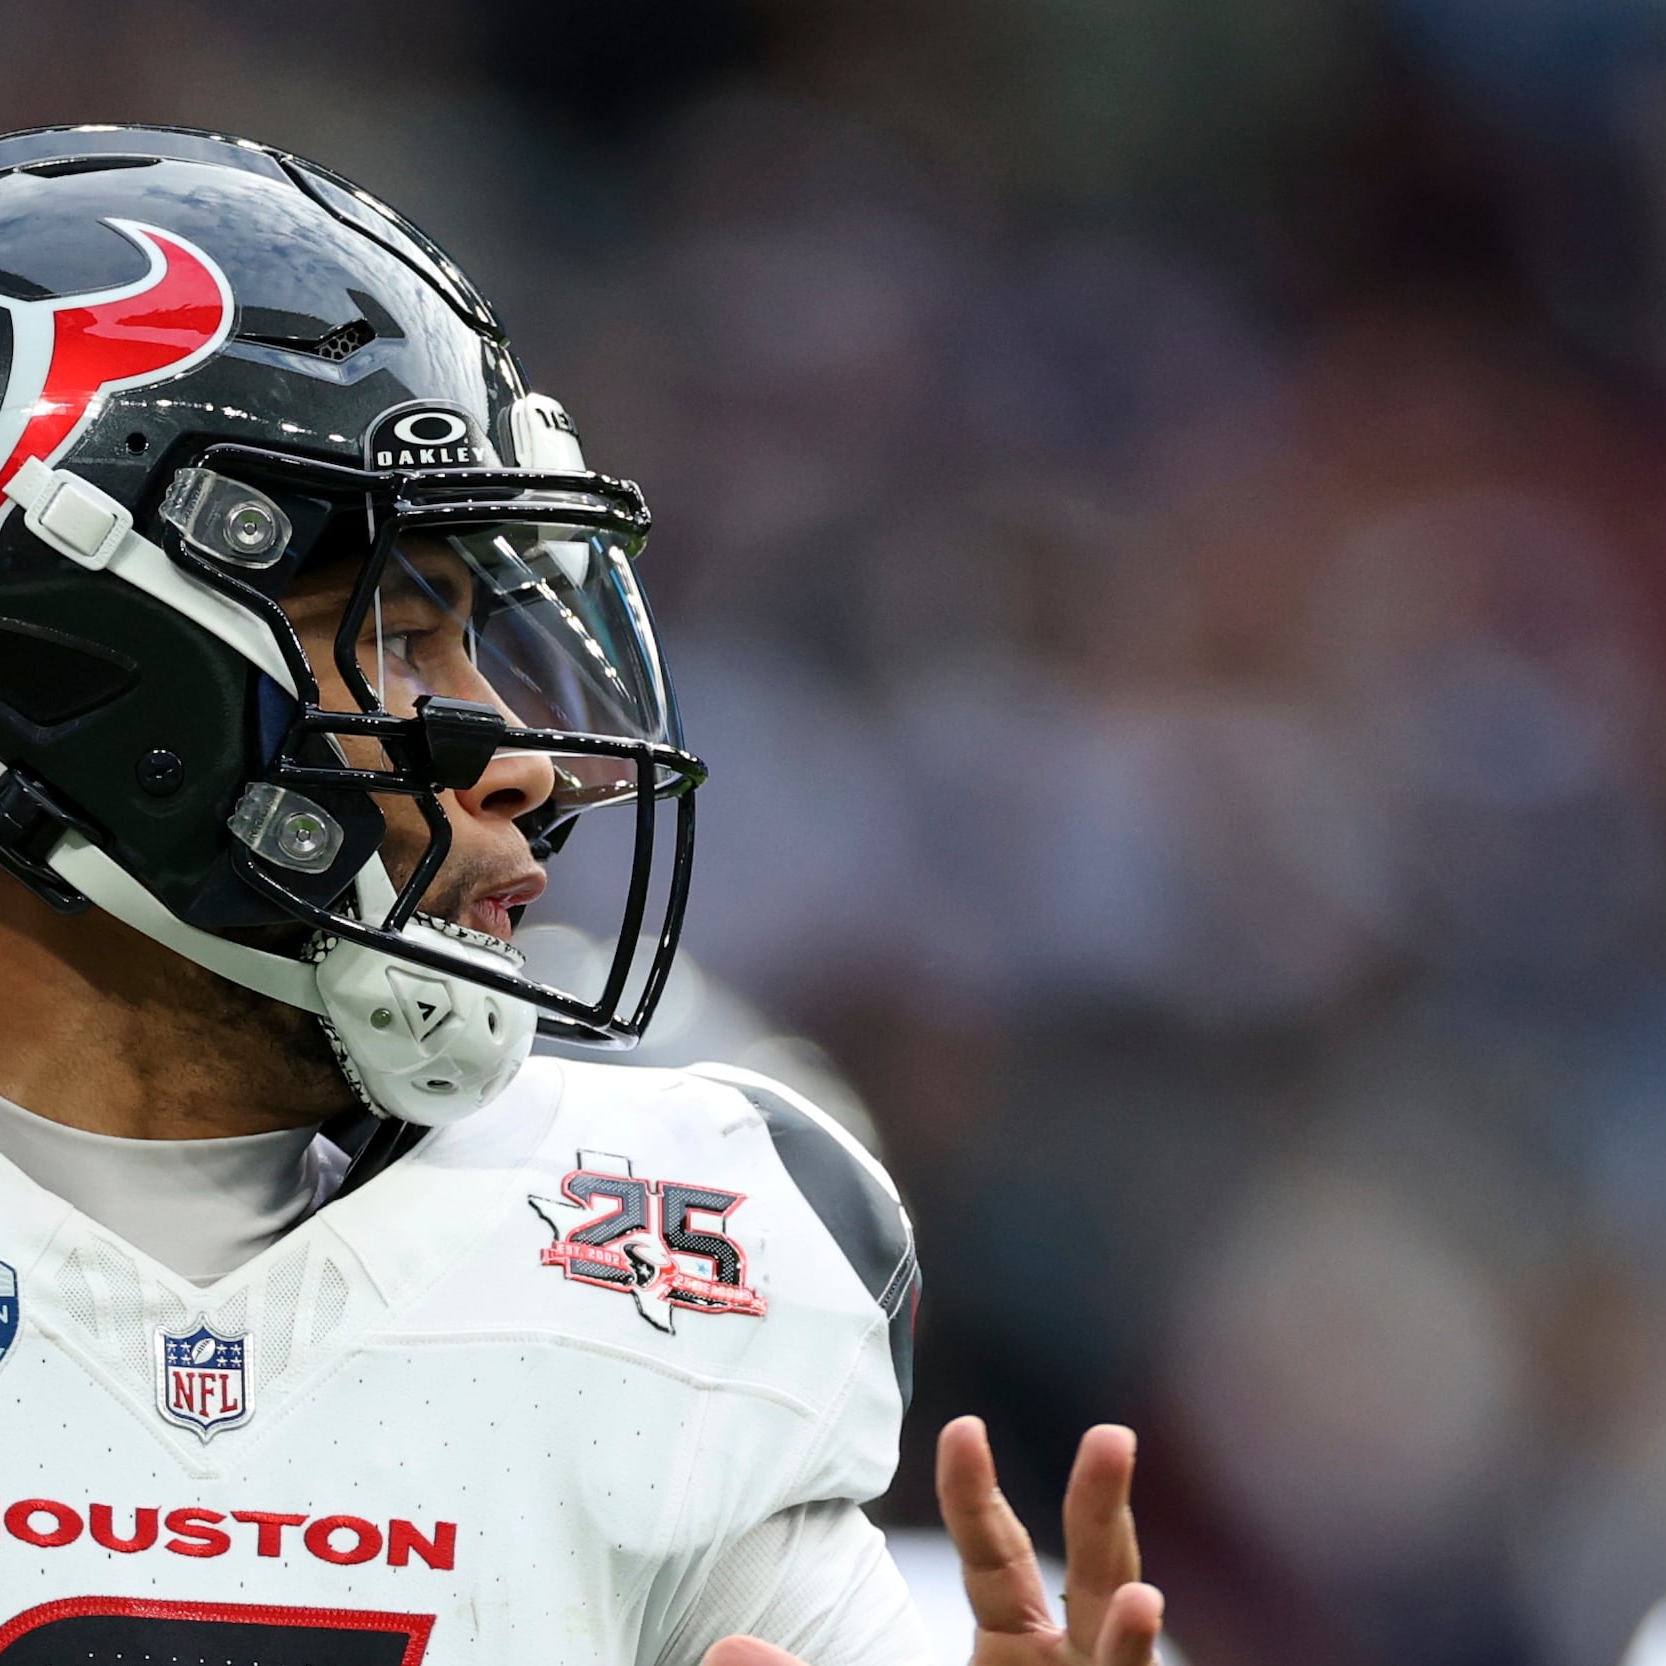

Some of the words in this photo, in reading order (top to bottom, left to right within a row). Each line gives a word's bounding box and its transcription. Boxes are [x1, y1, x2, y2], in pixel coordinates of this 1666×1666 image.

[376, 446, 486, 468] OAKLEY
[561, 1169, 749, 1314] 25
[587, 1247, 621, 1265] 2002
[172, 1370, 239, 1418] NFL
